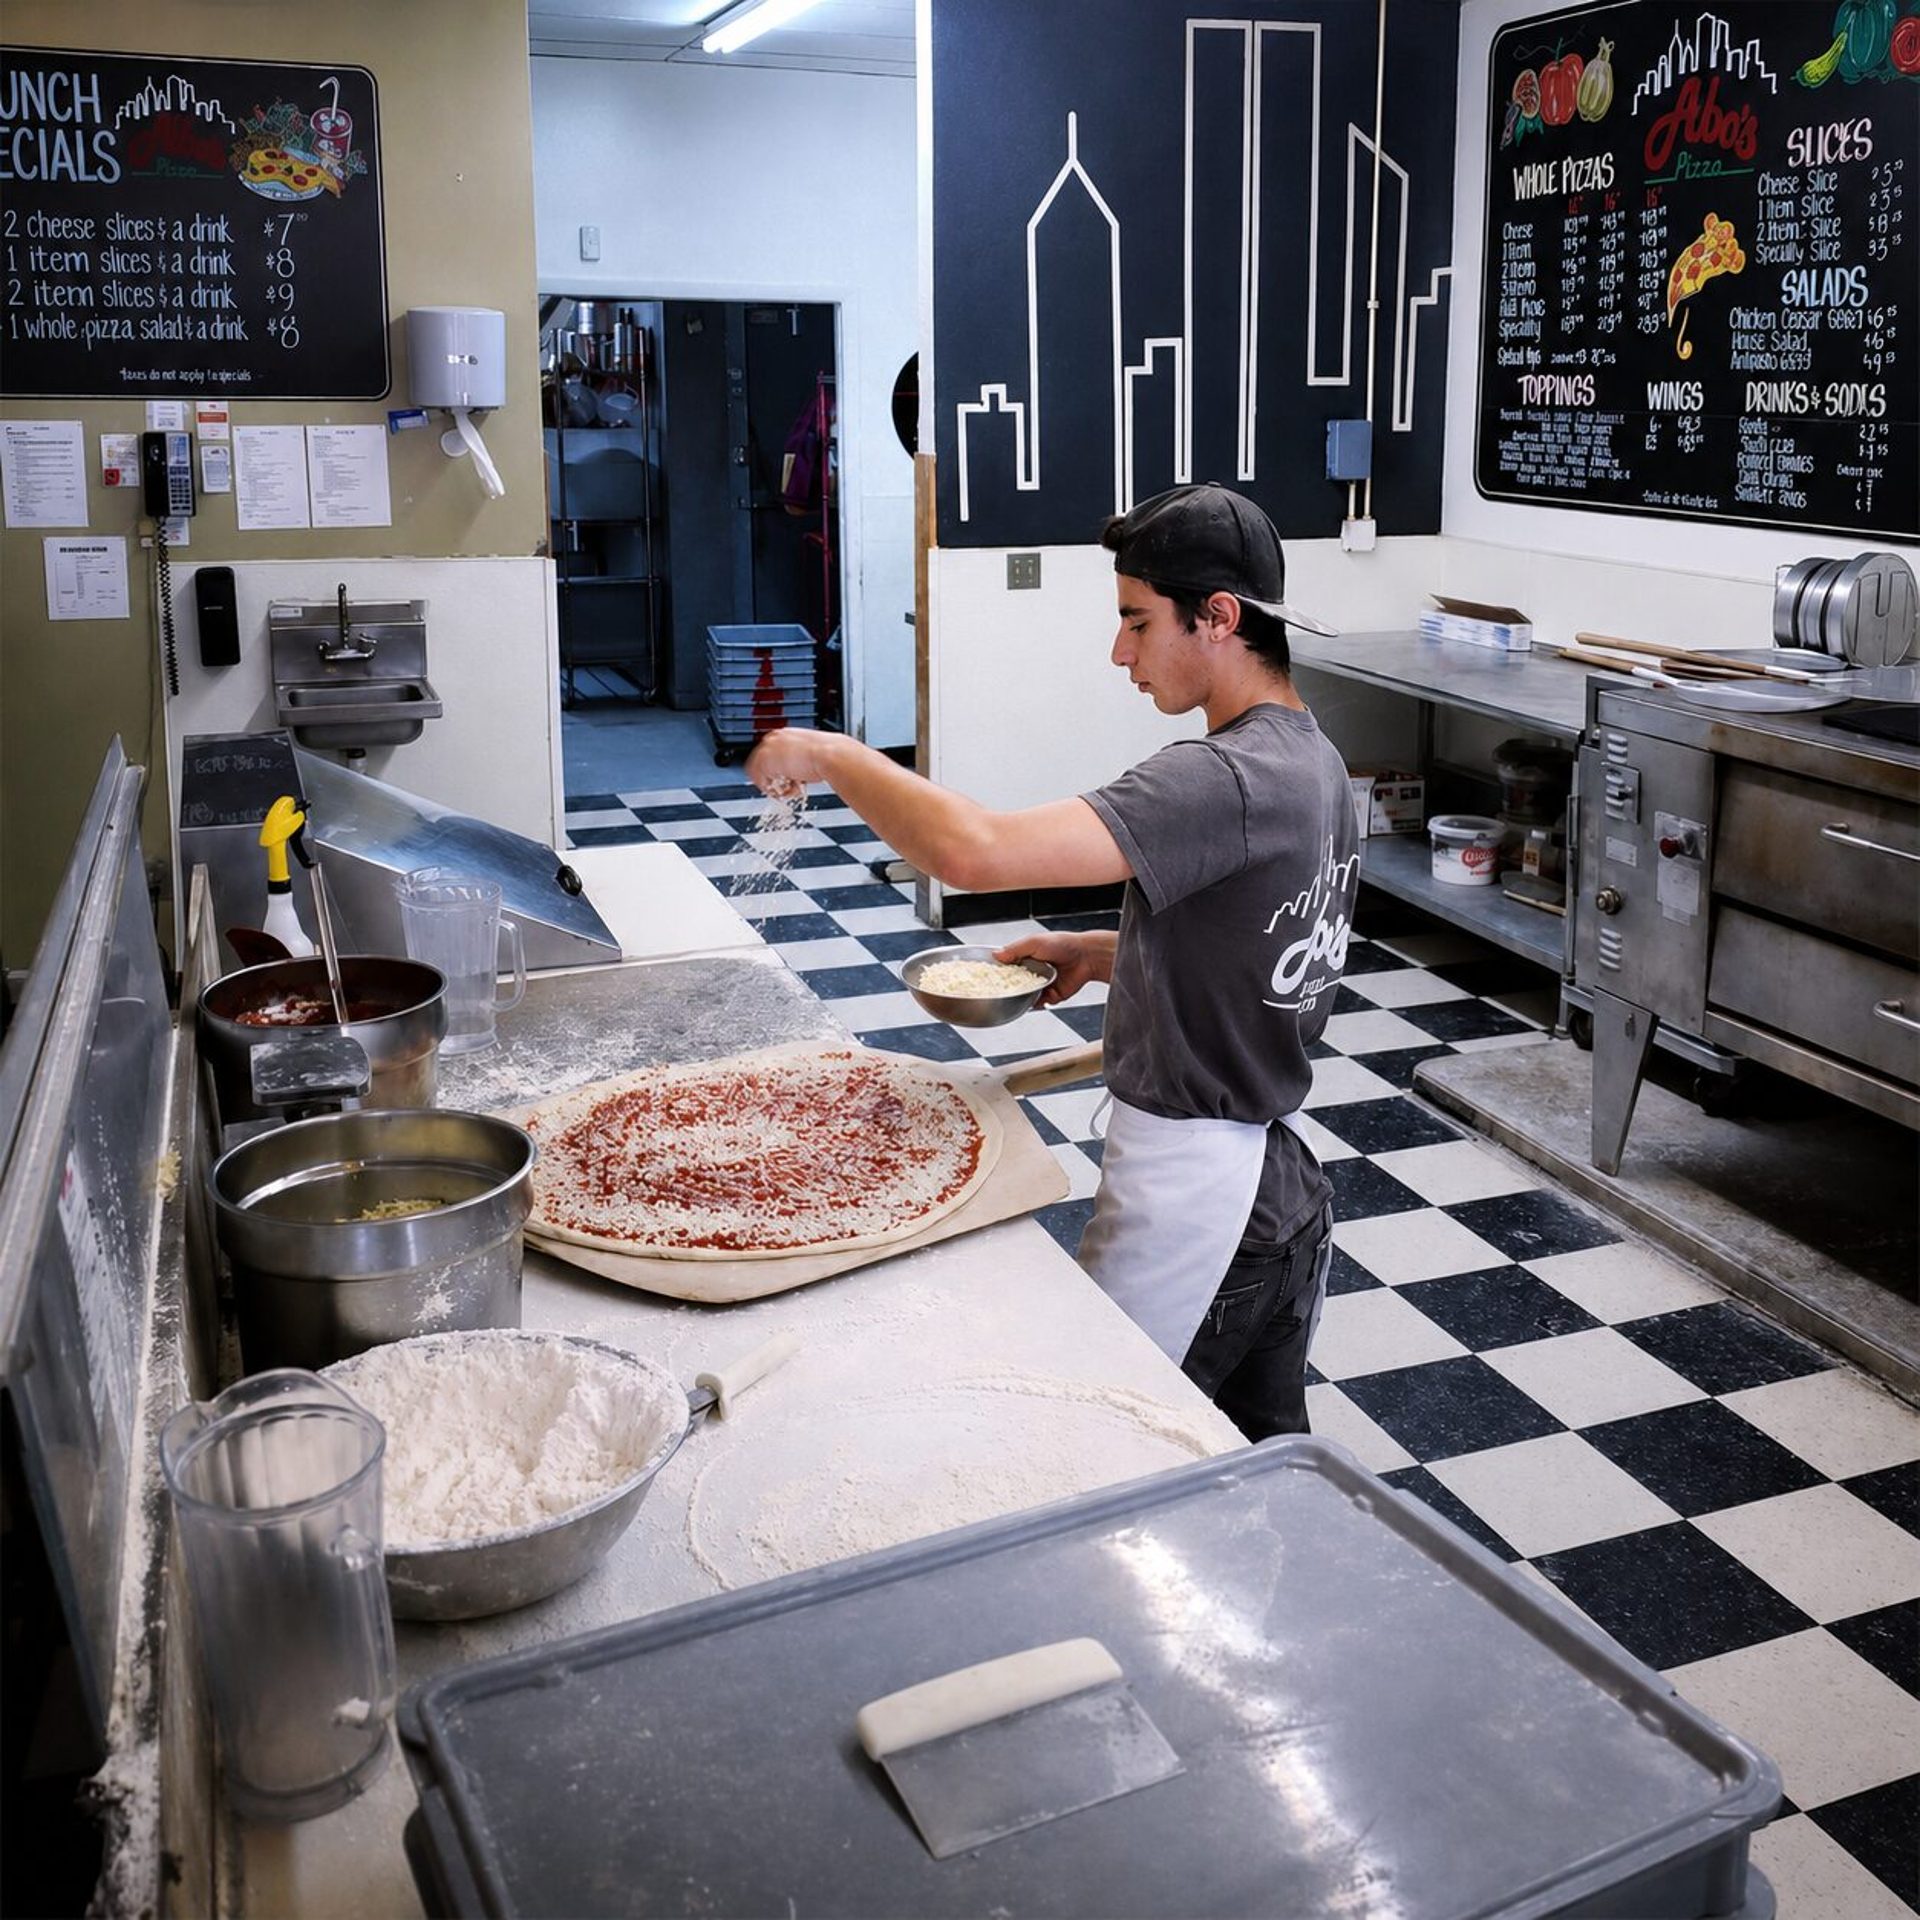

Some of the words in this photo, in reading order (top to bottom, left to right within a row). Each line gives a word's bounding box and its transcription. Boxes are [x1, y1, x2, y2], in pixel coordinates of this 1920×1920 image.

[1644, 76, 1758, 171] Abo's
[1787, 117, 1873, 168] SLICES
[1513, 161, 1558, 201] WHOLE
[1562, 152, 1615, 195] PIZZAS
[1675, 151, 1721, 180] Pizza
[1757, 171, 1800, 196] Cheese
[1806, 168, 1838, 193] Slice
[1758, 200, 1763, 221] 1
[1801, 194, 1834, 217] Slice
[4, 209, 20, 238] 2
[27, 209, 95, 239] cheese
[106, 211, 154, 241] slices
[172, 220, 183, 241] a
[189, 212, 235, 243] drink
[1756, 221, 1765, 241] 2
[1810, 216, 1841, 239] Slice
[8, 245, 17, 272] 1
[30, 245, 89, 273] item
[100, 246, 151, 273] slices
[171, 253, 183, 274] a
[190, 246, 236, 275] drink
[1810, 240, 1841, 262] Slice
[1501, 262, 1510, 280] 2
[1781, 265, 1869, 307] SALADS
[8, 279, 24, 306] 2
[34, 280, 94, 307] item
[103, 280, 155, 308] slices
[172, 286, 184, 308] a
[191, 280, 237, 308] drink
[10, 313, 19, 339] 1
[24, 311, 77, 340] whole
[85, 313, 135, 351] pizza
[140, 312, 182, 341] salad
[197, 321, 207, 341] a
[210, 314, 249, 341] drink
[1729, 306, 1777, 330] Chicken
[162, 368, 176, 380] not
[1517, 374, 1596, 406] TOPPINGS
[1647, 381, 1704, 411] WINGS
[1745, 380, 1809, 414] DRINKS
[1811, 386, 1821, 410] &
